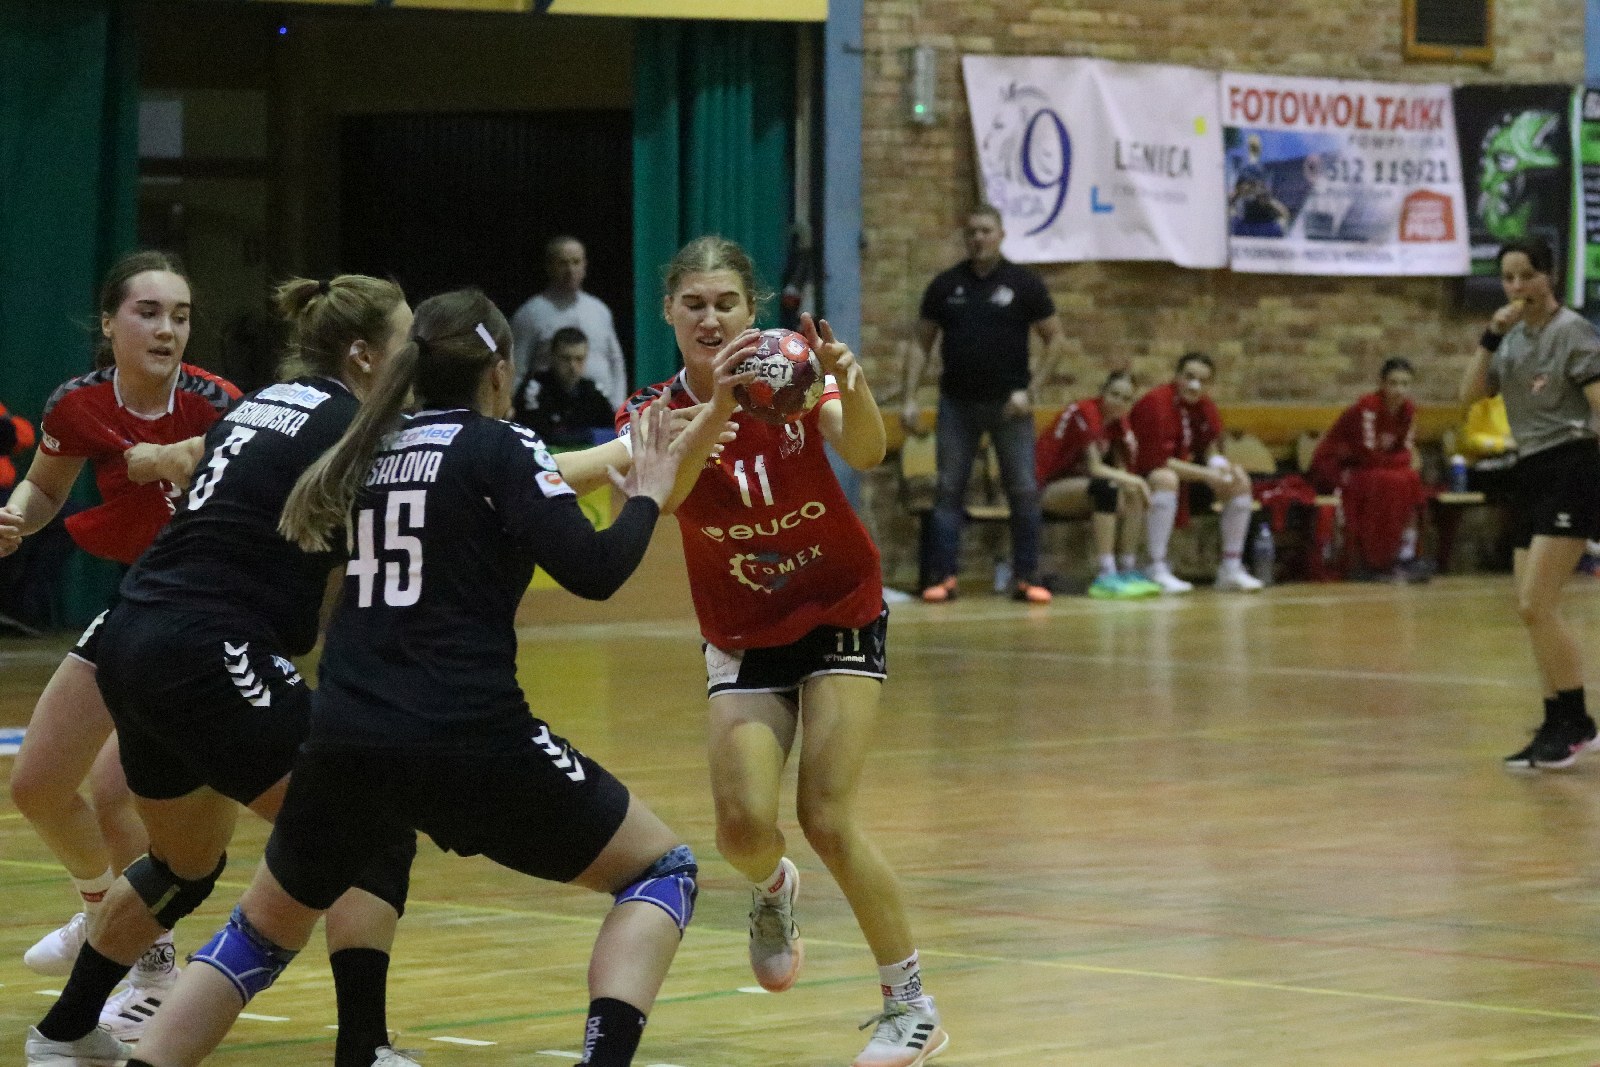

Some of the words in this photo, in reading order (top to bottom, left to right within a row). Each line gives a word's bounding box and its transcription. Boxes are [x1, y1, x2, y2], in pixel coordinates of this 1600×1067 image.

[188, 425, 258, 511] 5
[734, 454, 774, 508] 11
[346, 490, 427, 608] 45
[746, 544, 823, 575] TOMEX
[833, 654, 866, 663] hummel
[835, 628, 860, 653] 11
